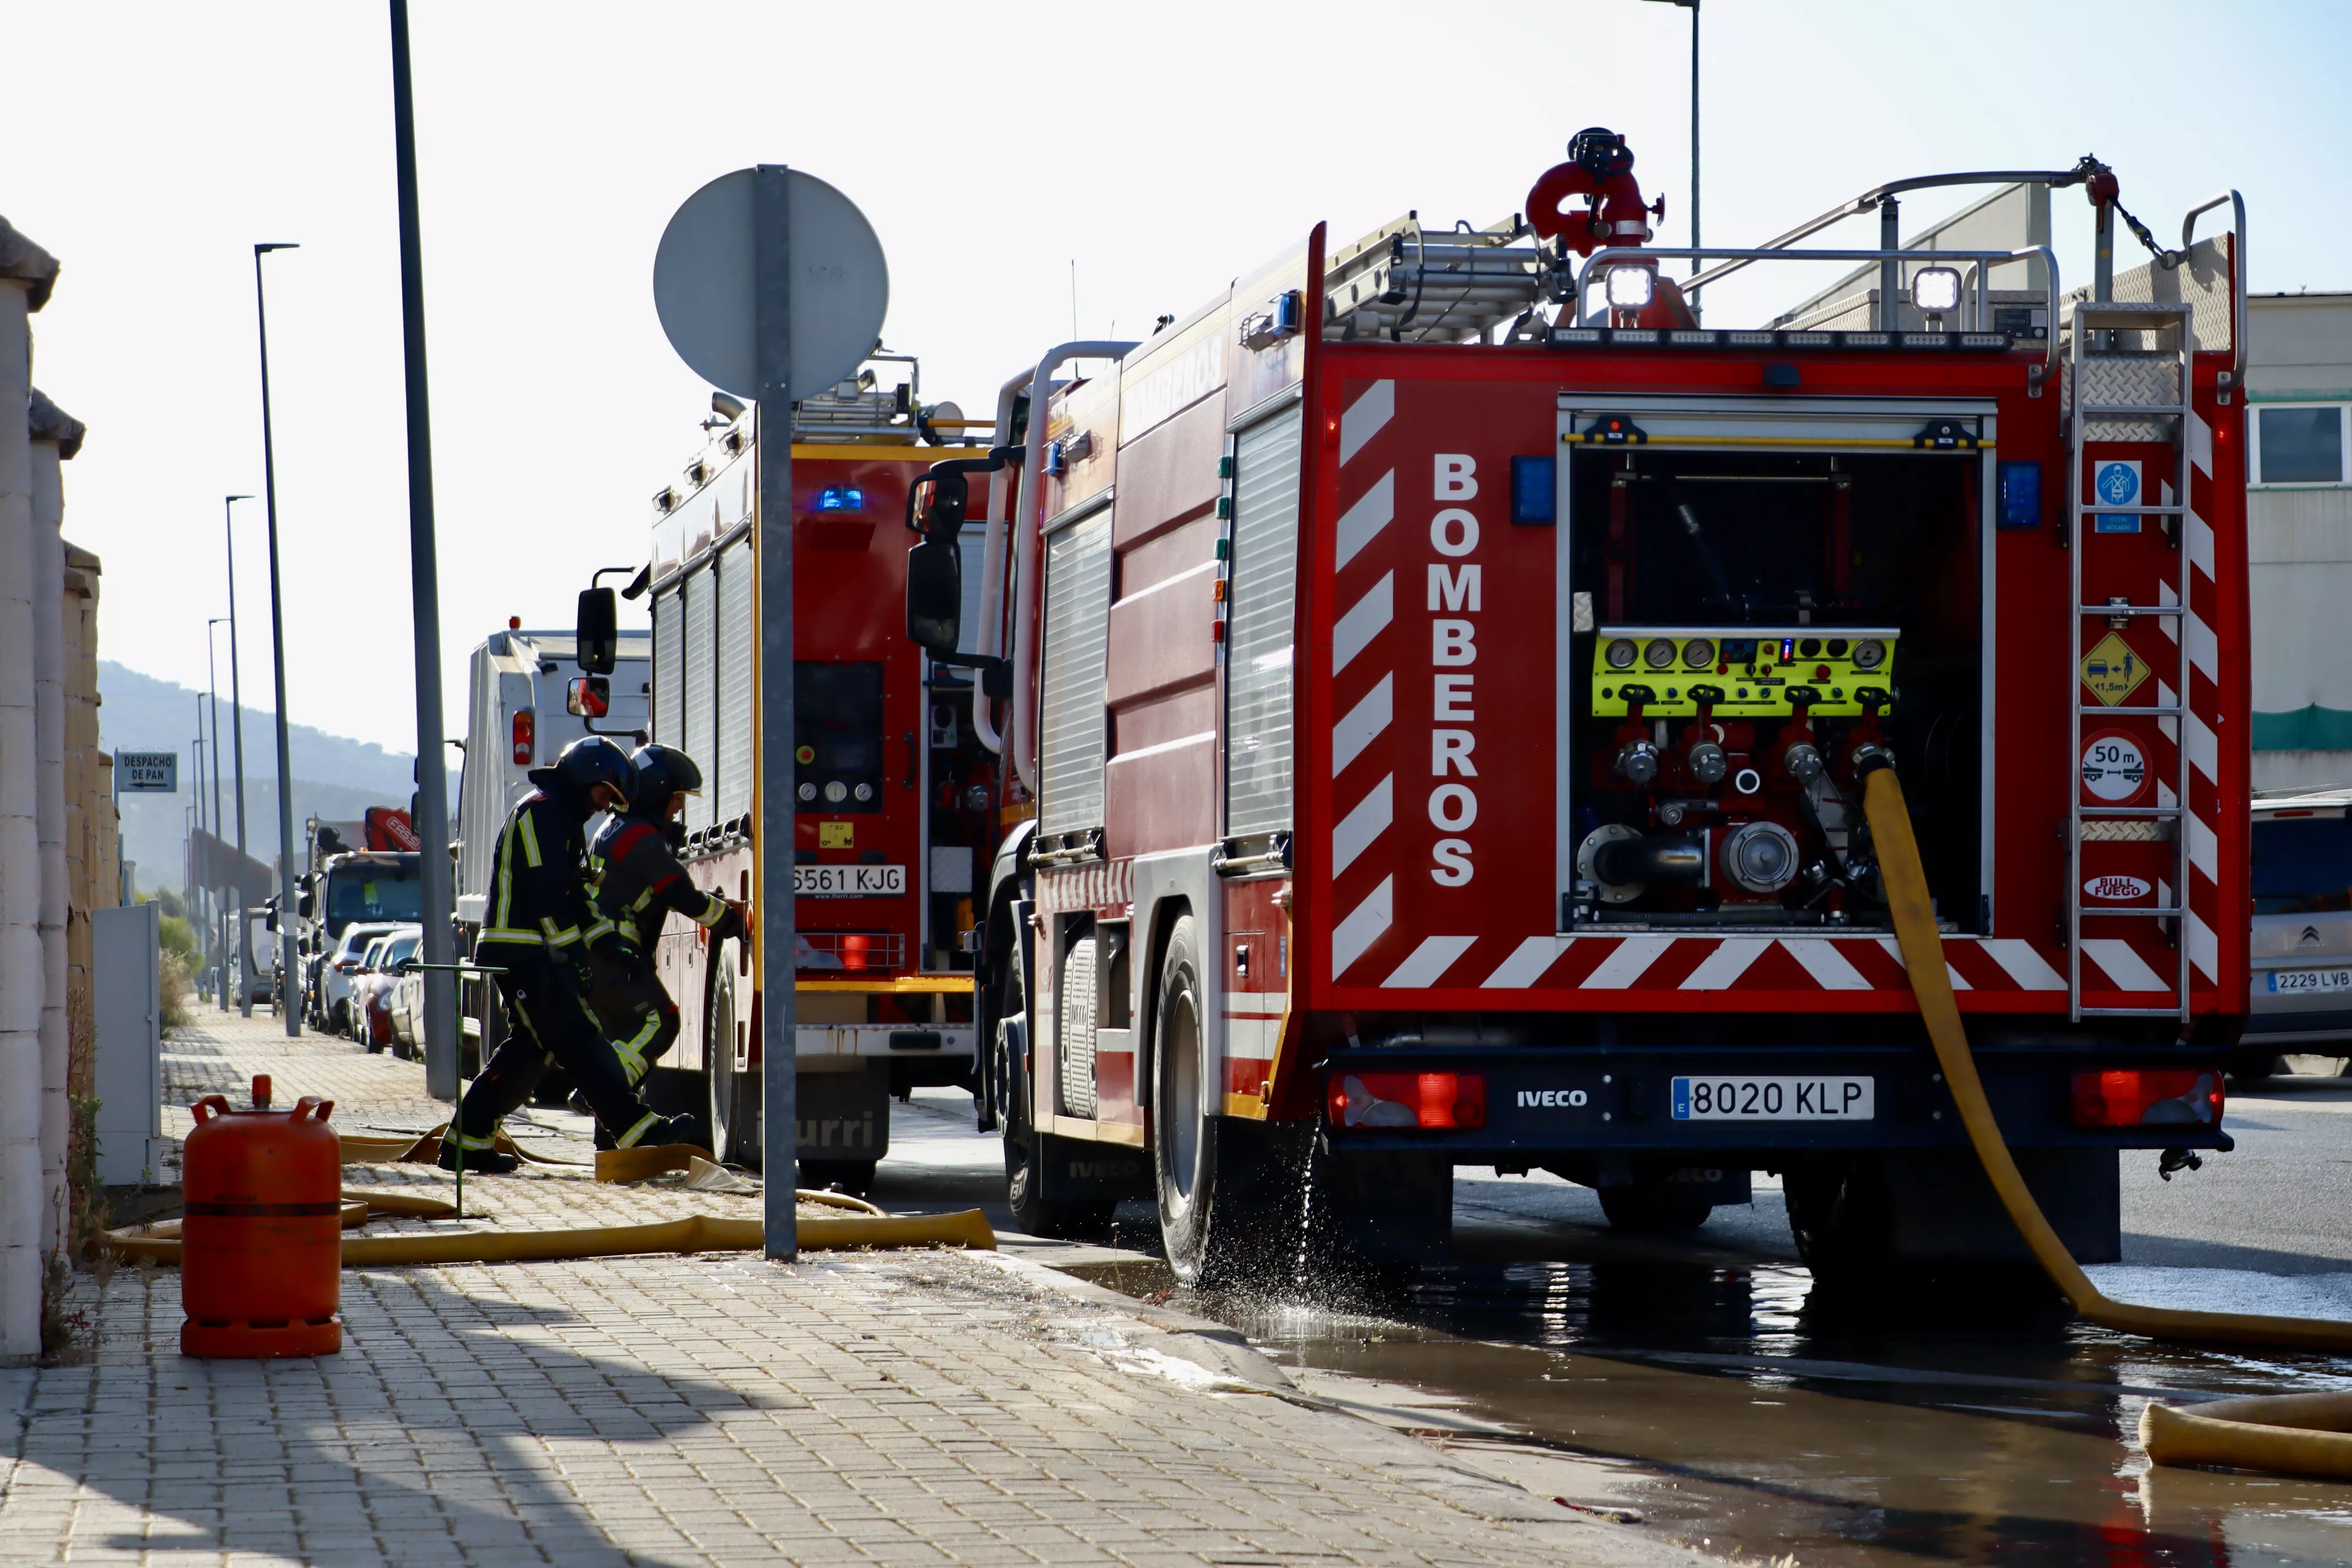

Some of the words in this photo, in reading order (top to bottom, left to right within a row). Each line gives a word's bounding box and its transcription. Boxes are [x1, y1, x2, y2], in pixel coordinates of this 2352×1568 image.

[1427, 453, 1482, 887] BOMBEROS
[2100, 682, 2124, 692] 1,5m
[124, 756, 172, 767] DESPACHO
[2095, 746, 2120, 763] 50
[2123, 753, 2135, 763] m
[132, 769, 143, 780] DE
[146, 769, 164, 780] PAN
[857, 868, 900, 890] KJG
[2100, 877, 2134, 887] BULL
[2095, 886, 2141, 896] FUEGO
[2279, 973, 2317, 988] 2229
[2321, 972, 2350, 986] LVB
[1517, 1089, 1587, 1107] IVECO
[1677, 1103, 1686, 1113] E
[1693, 1082, 1783, 1115] 8020
[1796, 1082, 1863, 1114] KLP
[756, 1110, 873, 1146] iurri
[1069, 1161, 1141, 1178] IVECO
